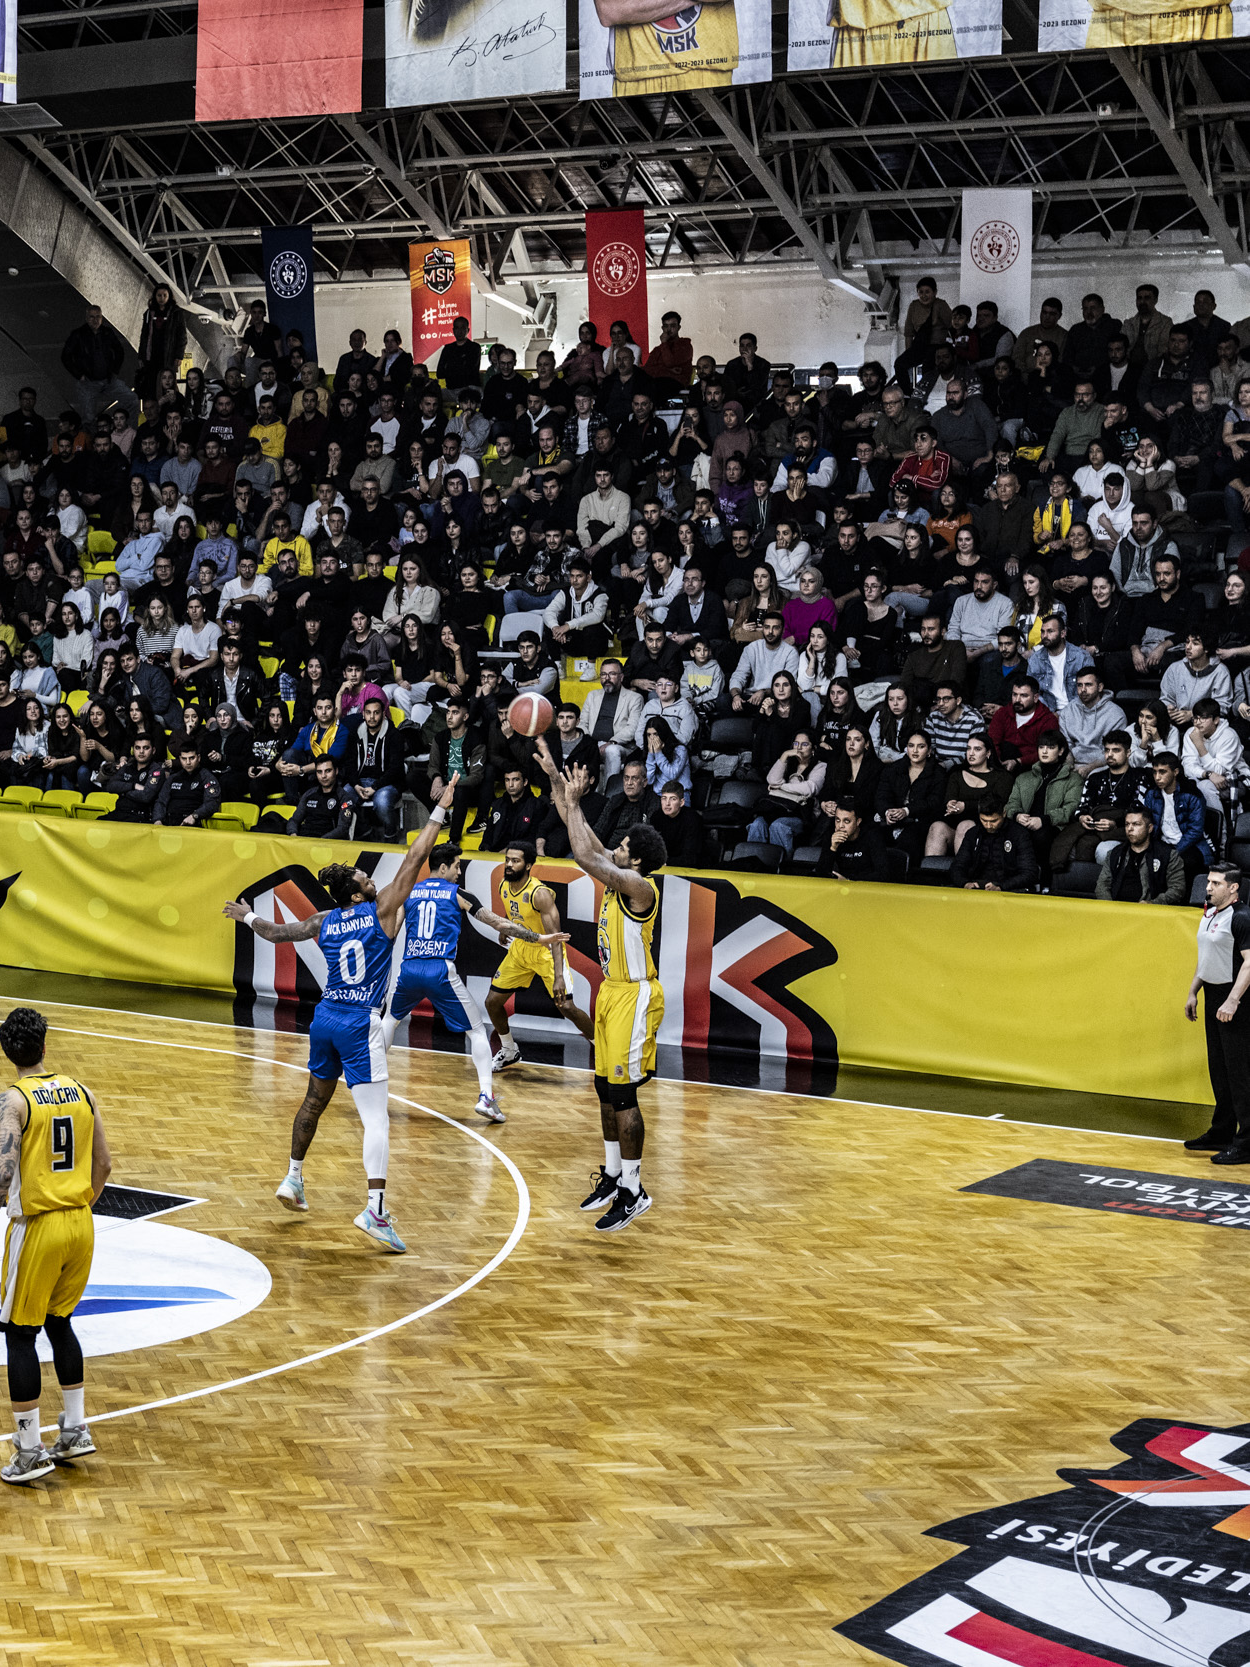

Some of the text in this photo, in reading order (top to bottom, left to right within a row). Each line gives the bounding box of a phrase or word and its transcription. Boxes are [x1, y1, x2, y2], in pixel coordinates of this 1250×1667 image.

[1158, 10, 1194, 19] 2022-2023
[1196, 7, 1223, 16] SEZONU
[1061, 18, 1087, 26] SEZONU
[656, 26, 699, 54] MSK
[894, 28, 952, 39] 2022-2023 SEZONU
[807, 39, 831, 47] SEZONU
[674, 57, 728, 68] 2022-2023 SEZONU
[423, 268, 455, 284] MSK
[509, 900, 520, 913] 29
[341, 915, 374, 934] BANYARD
[417, 900, 437, 940] 10
[338, 939, 367, 985] 0
[52, 1115, 75, 1173] 9
